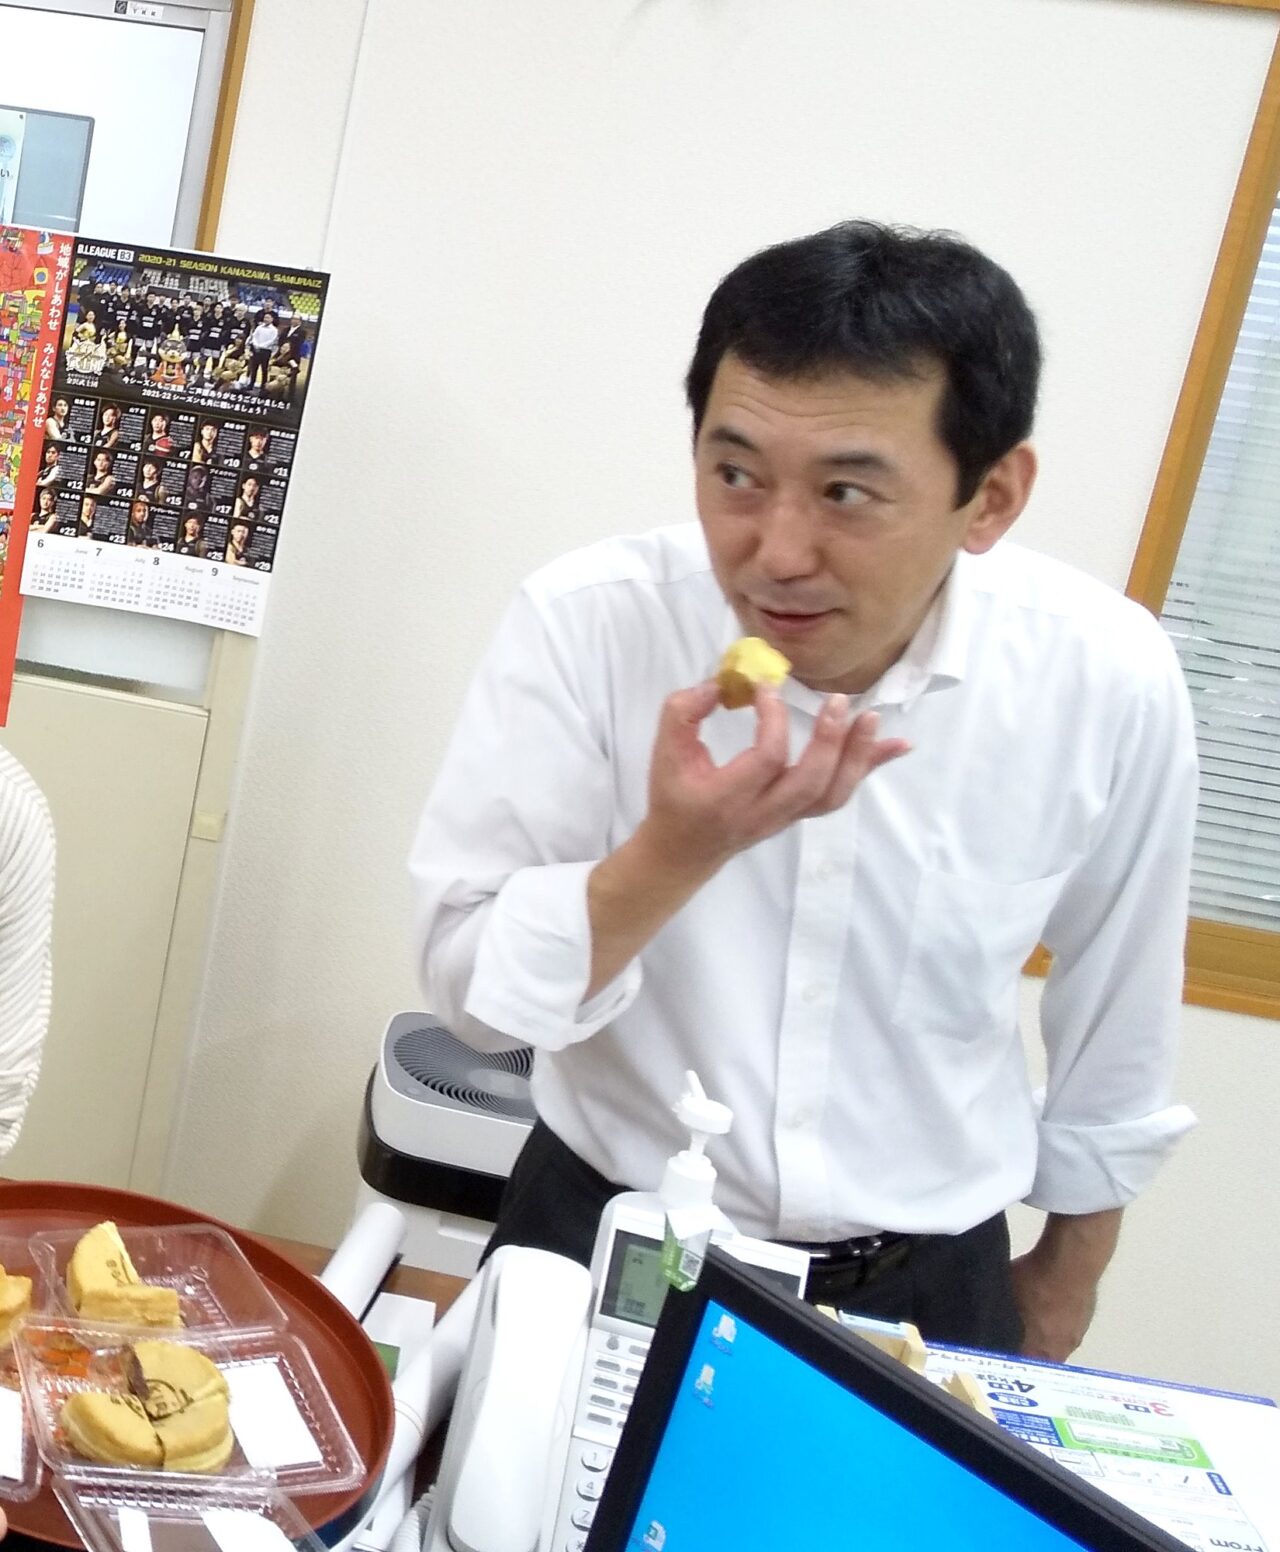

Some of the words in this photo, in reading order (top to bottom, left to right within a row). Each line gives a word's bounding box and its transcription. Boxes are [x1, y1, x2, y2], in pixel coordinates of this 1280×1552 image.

[77, 244, 117, 260] B.LEAGUE
[138, 253, 177, 267] 2020-21
[179, 259, 218, 273] SEASON
[220, 266, 271, 282] KANAZAWA
[273, 273, 323, 288] SAMURAIZ
[47, 243, 71, 331] 地域がしあわせ
[33, 342, 55, 428] みんなしあわせ
[80, 434, 92, 444] #3
[130, 443, 141, 452] #5
[179, 450, 191, 459] #7
[223, 458, 240, 468] #10
[273, 467, 288, 477] #11
[67, 480, 83, 490] #12
[117, 488, 133, 498] #14
[165, 496, 182, 506] #15
[215, 504, 232, 514] #17
[60, 527, 77, 536] #22
[37, 539, 44, 548] 6
[108, 534, 126, 544] #23
[95, 547, 102, 556] 7
[152, 556, 160, 565] 8
[211, 567, 219, 576] 9
